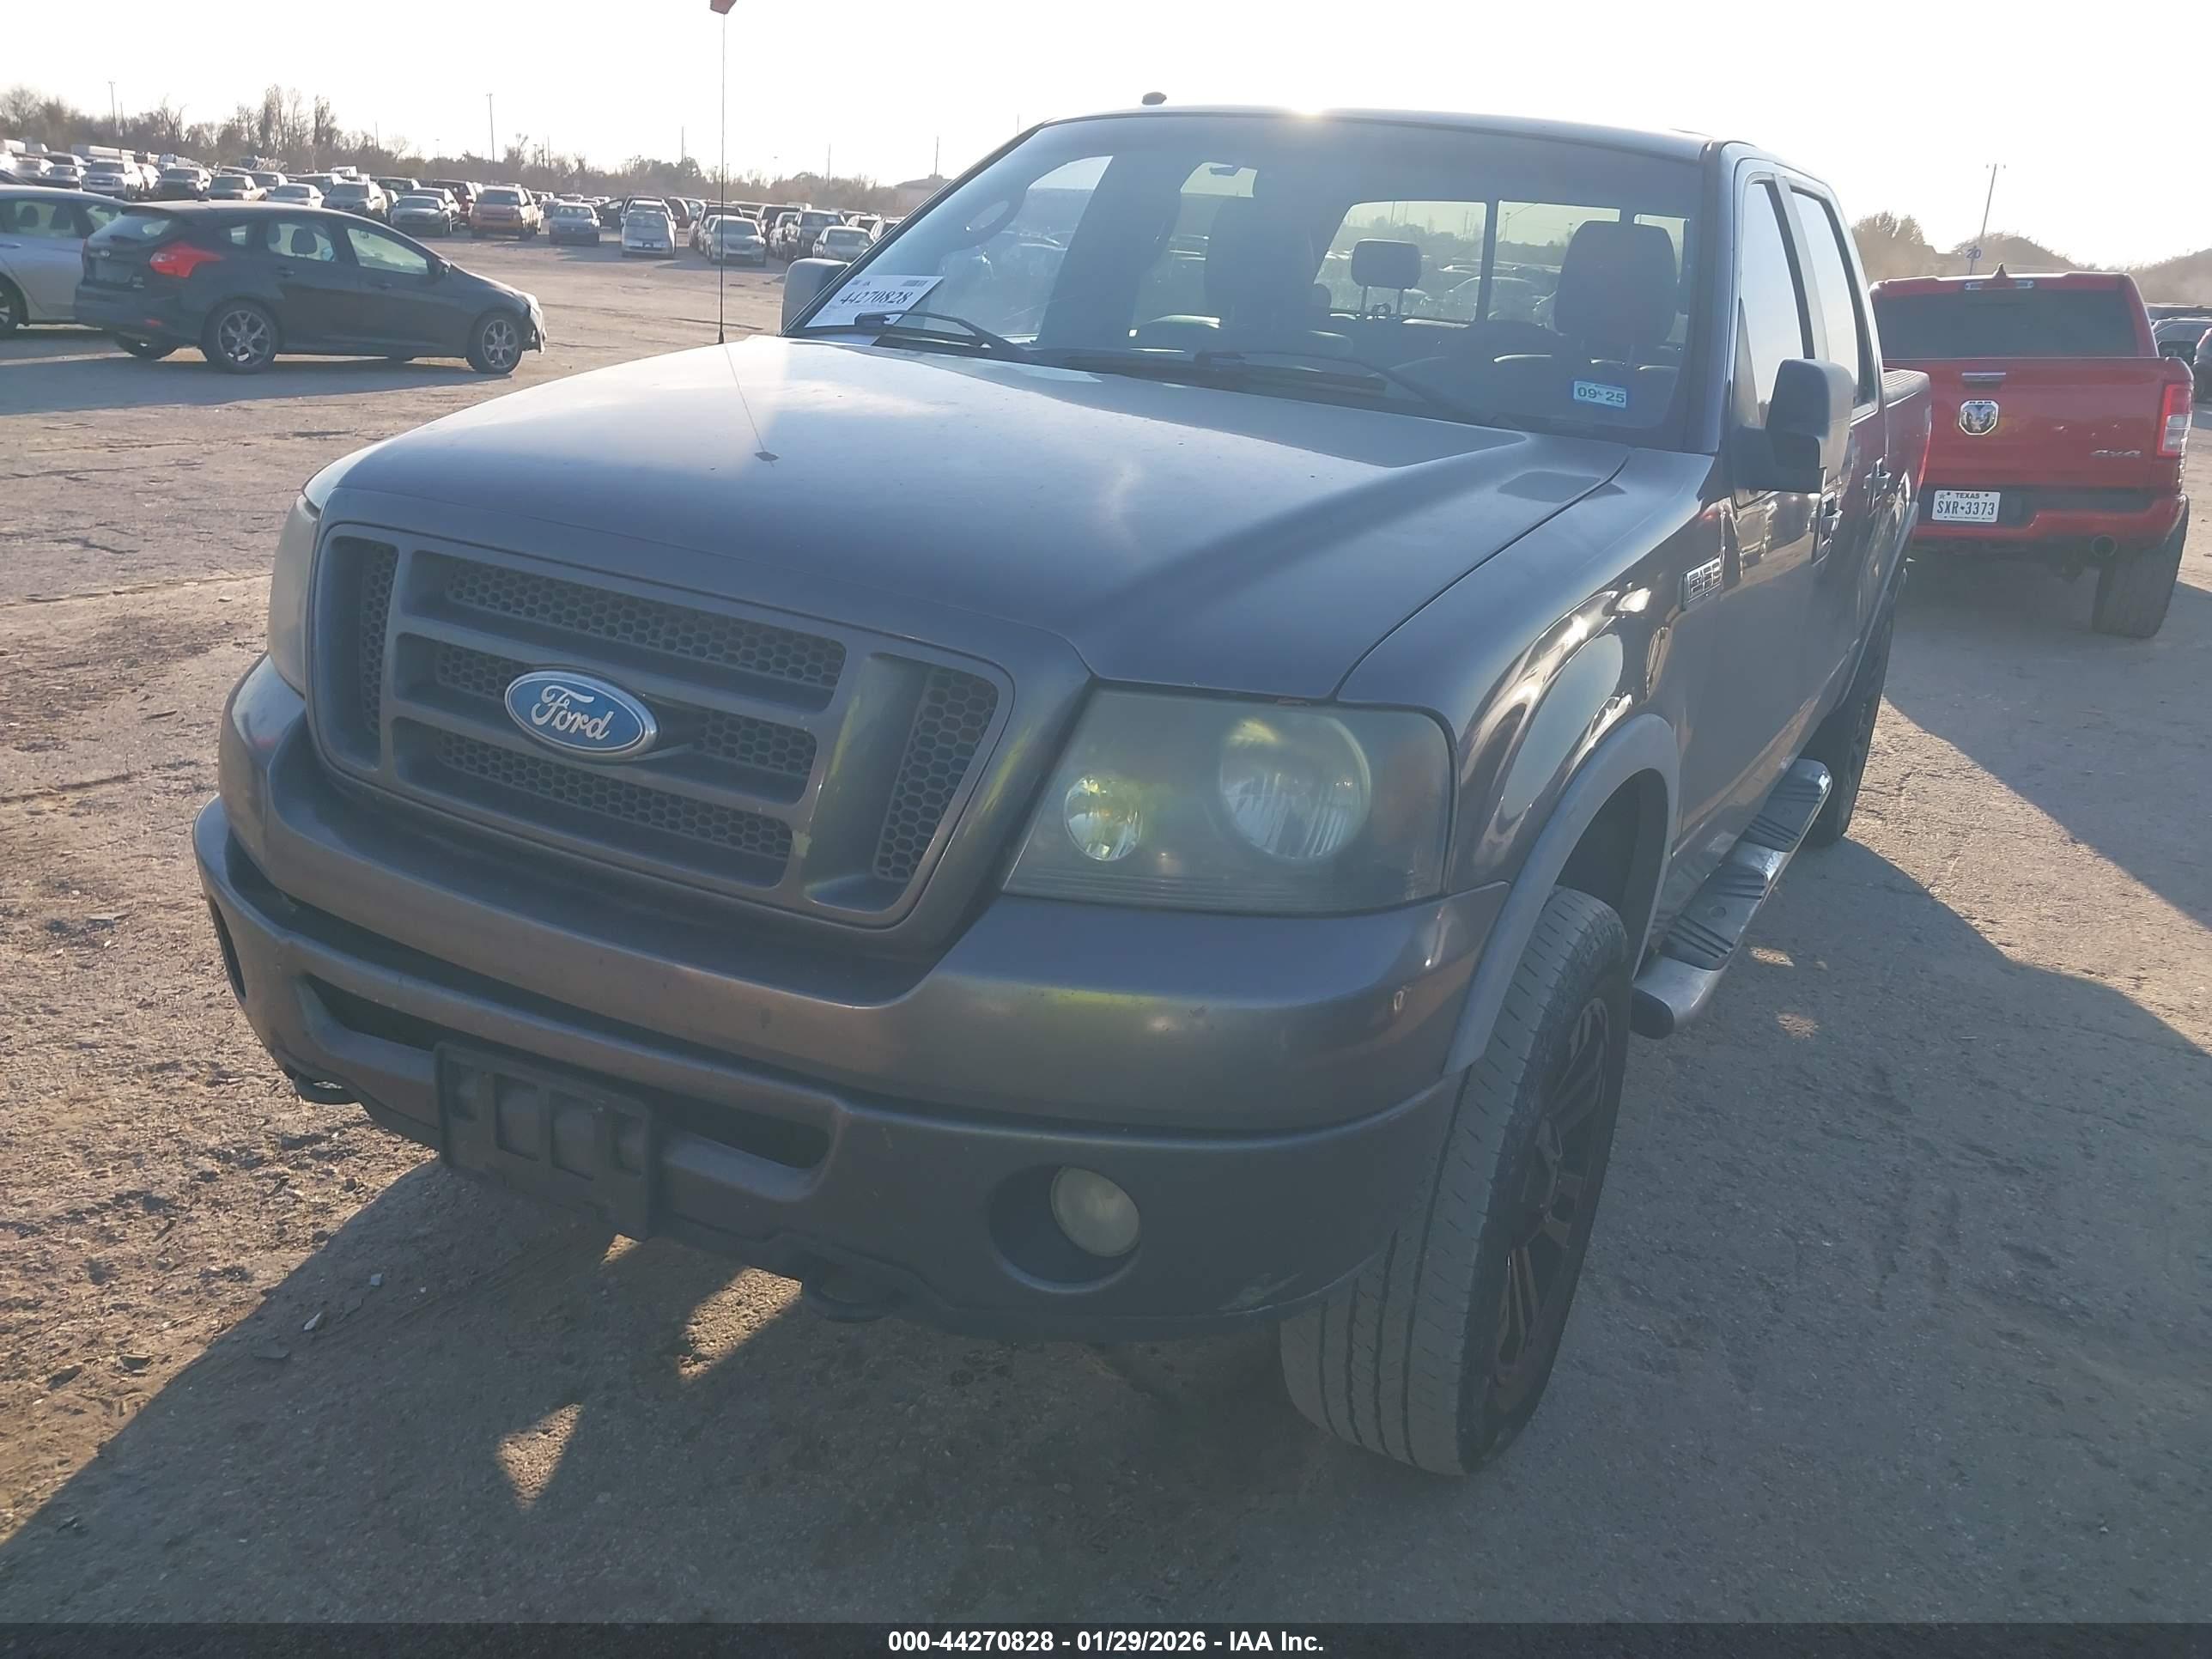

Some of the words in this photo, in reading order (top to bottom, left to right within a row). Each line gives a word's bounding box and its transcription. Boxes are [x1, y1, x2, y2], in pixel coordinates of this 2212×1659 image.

[840, 290, 914, 305] 44270828
[1577, 386, 1597, 399] 09
[1605, 391, 1626, 404] 25
[531, 684, 615, 741] Ford
